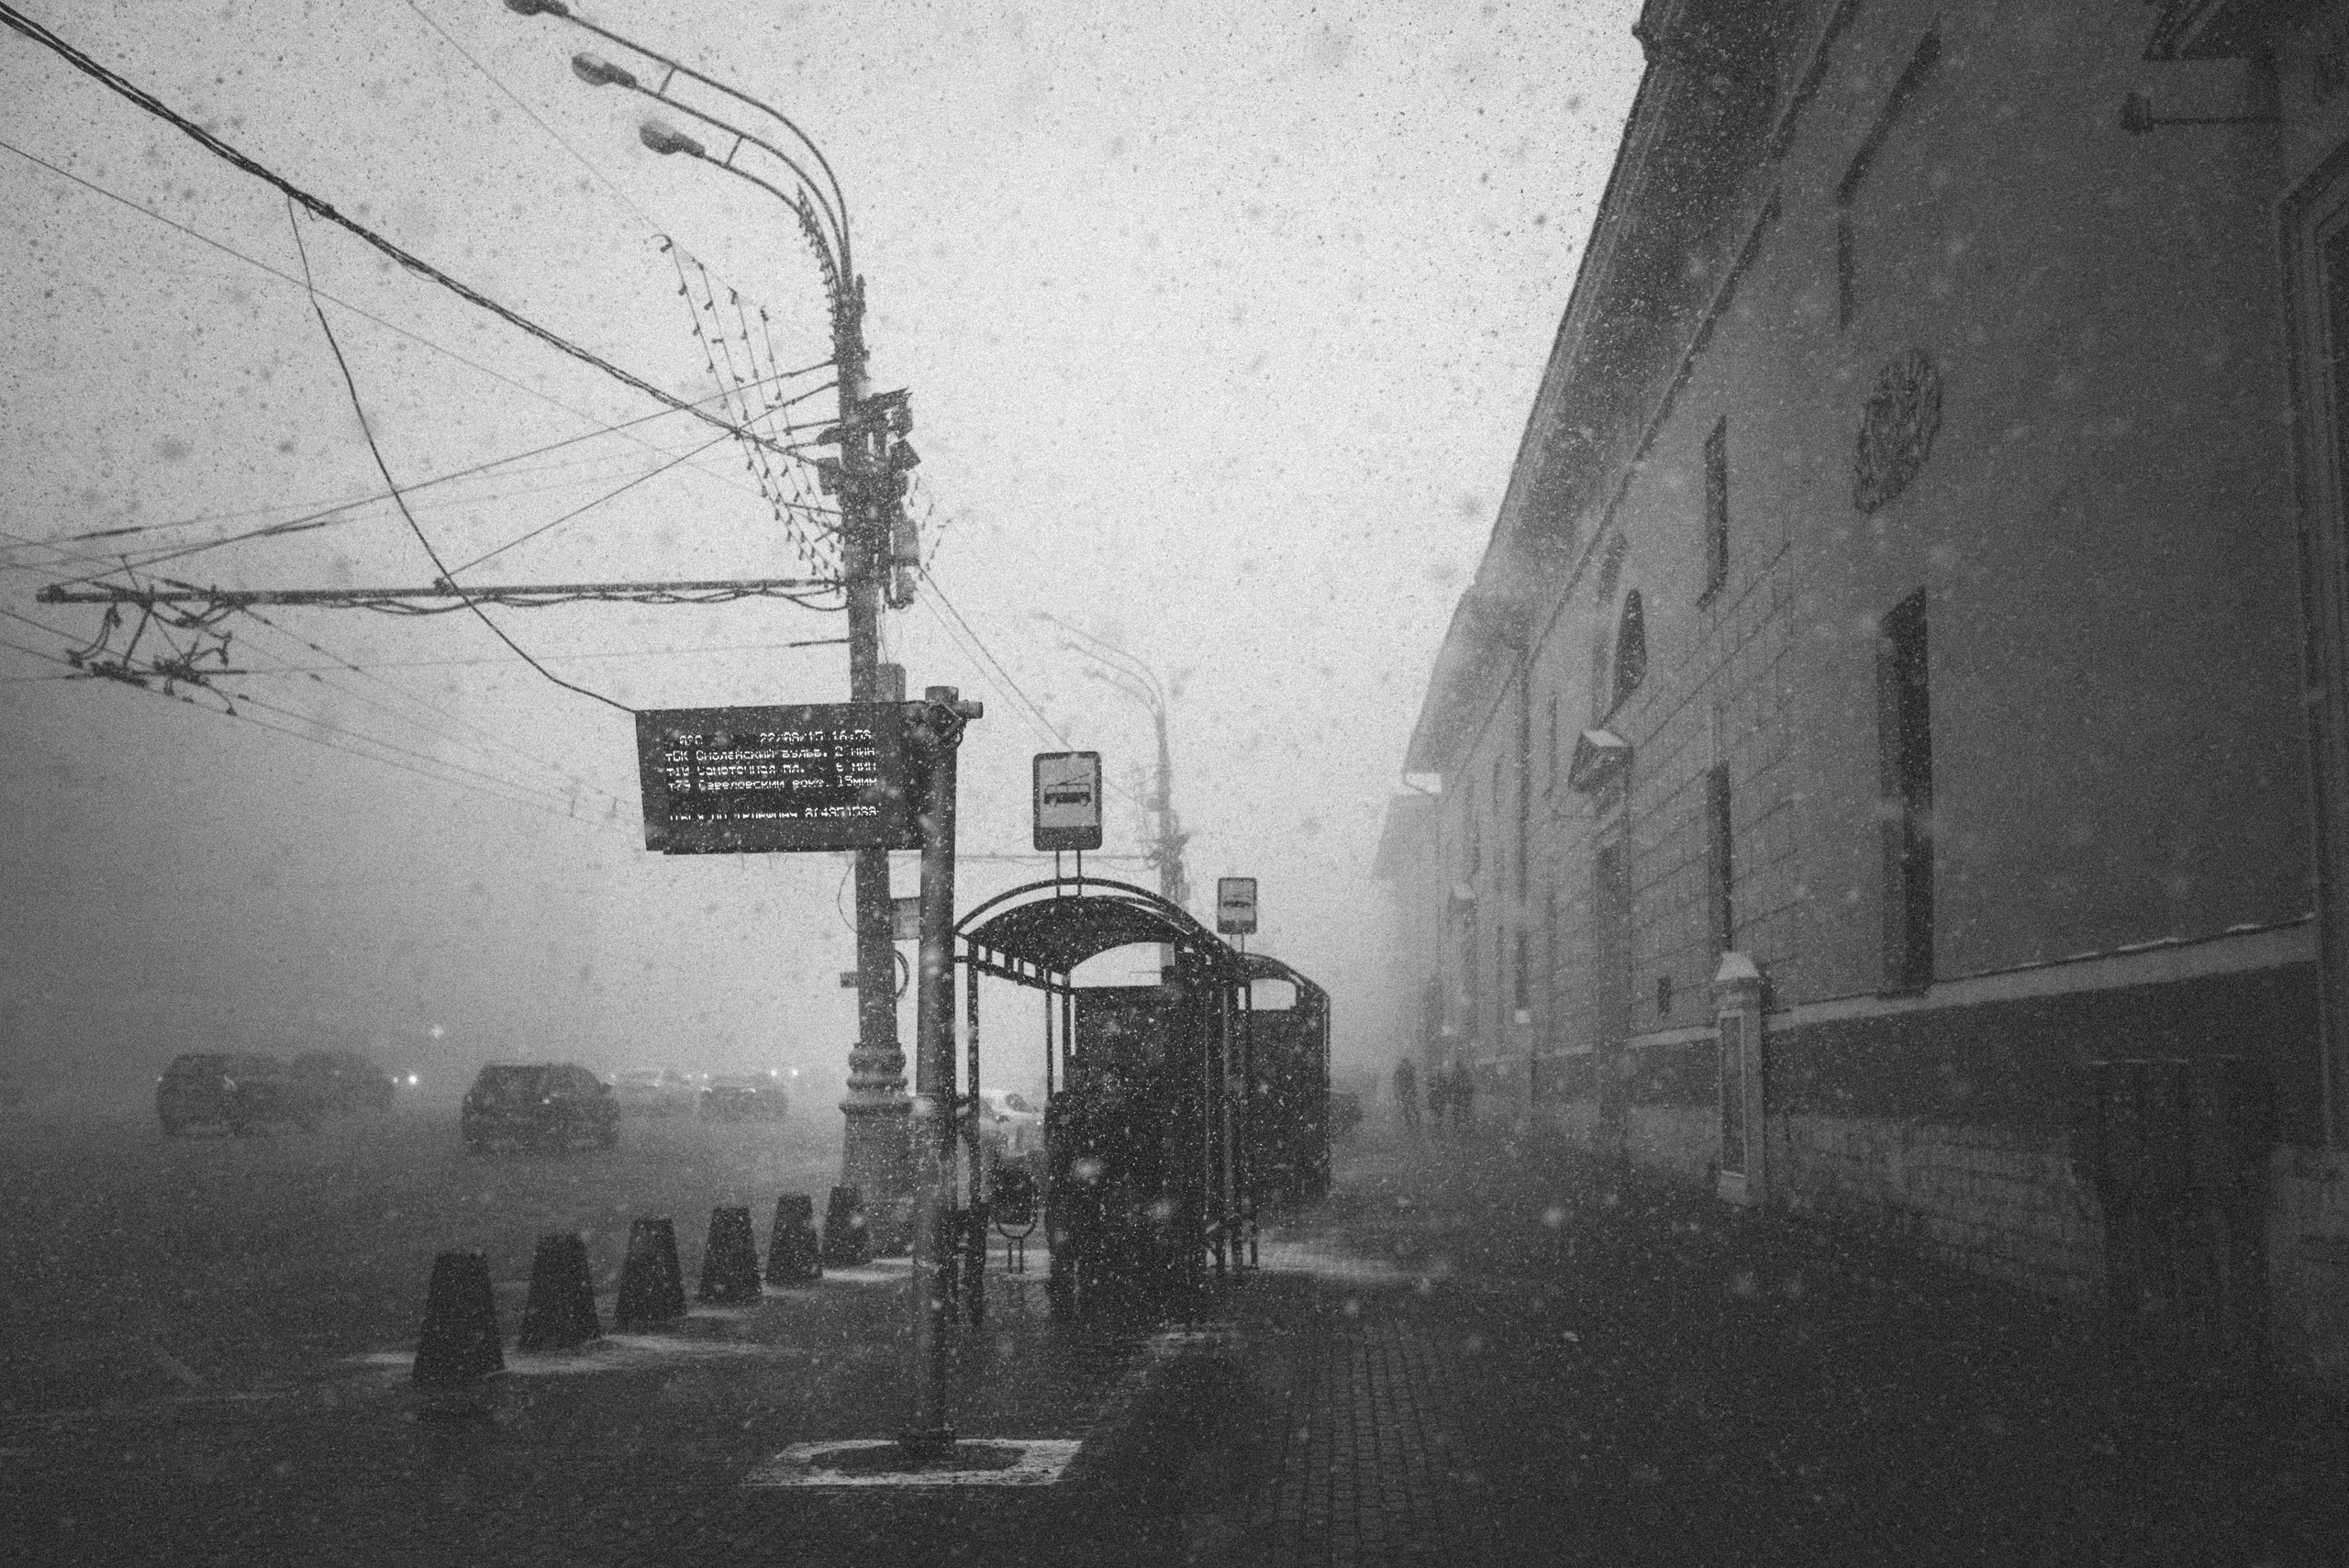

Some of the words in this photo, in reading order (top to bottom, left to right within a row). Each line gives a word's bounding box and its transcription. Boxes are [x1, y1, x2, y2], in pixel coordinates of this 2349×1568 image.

[696, 748, 775, 761] Смоленский
[834, 746, 844, 757] 2
[851, 746, 876, 757] мин
[696, 764, 776, 776] Самотечная
[835, 762, 844, 772] 6
[852, 762, 877, 772] мин
